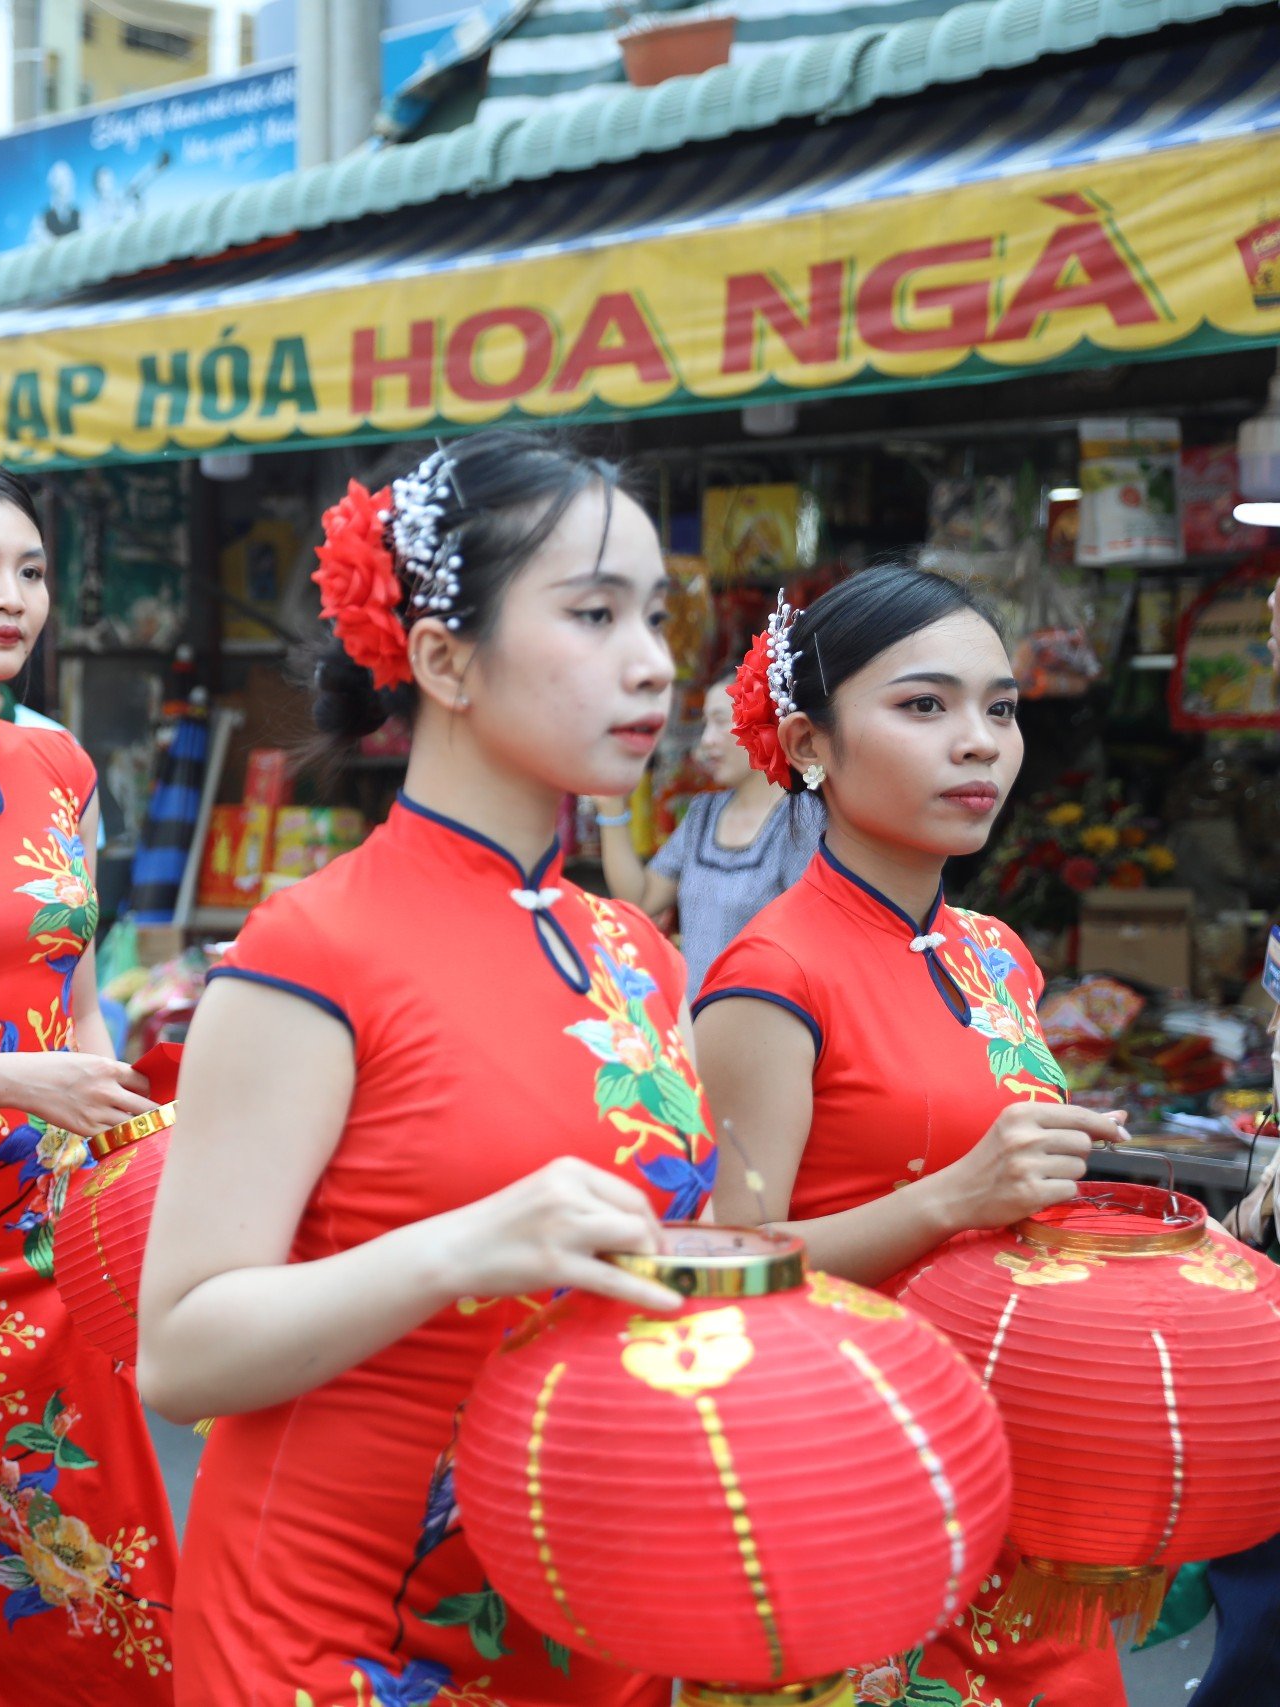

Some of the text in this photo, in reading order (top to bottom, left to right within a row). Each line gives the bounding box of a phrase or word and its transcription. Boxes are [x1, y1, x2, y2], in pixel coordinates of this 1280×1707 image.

[132, 321, 318, 429] HÓA
[350, 287, 677, 415] HOA
[720, 188, 1175, 375] NGÀ
